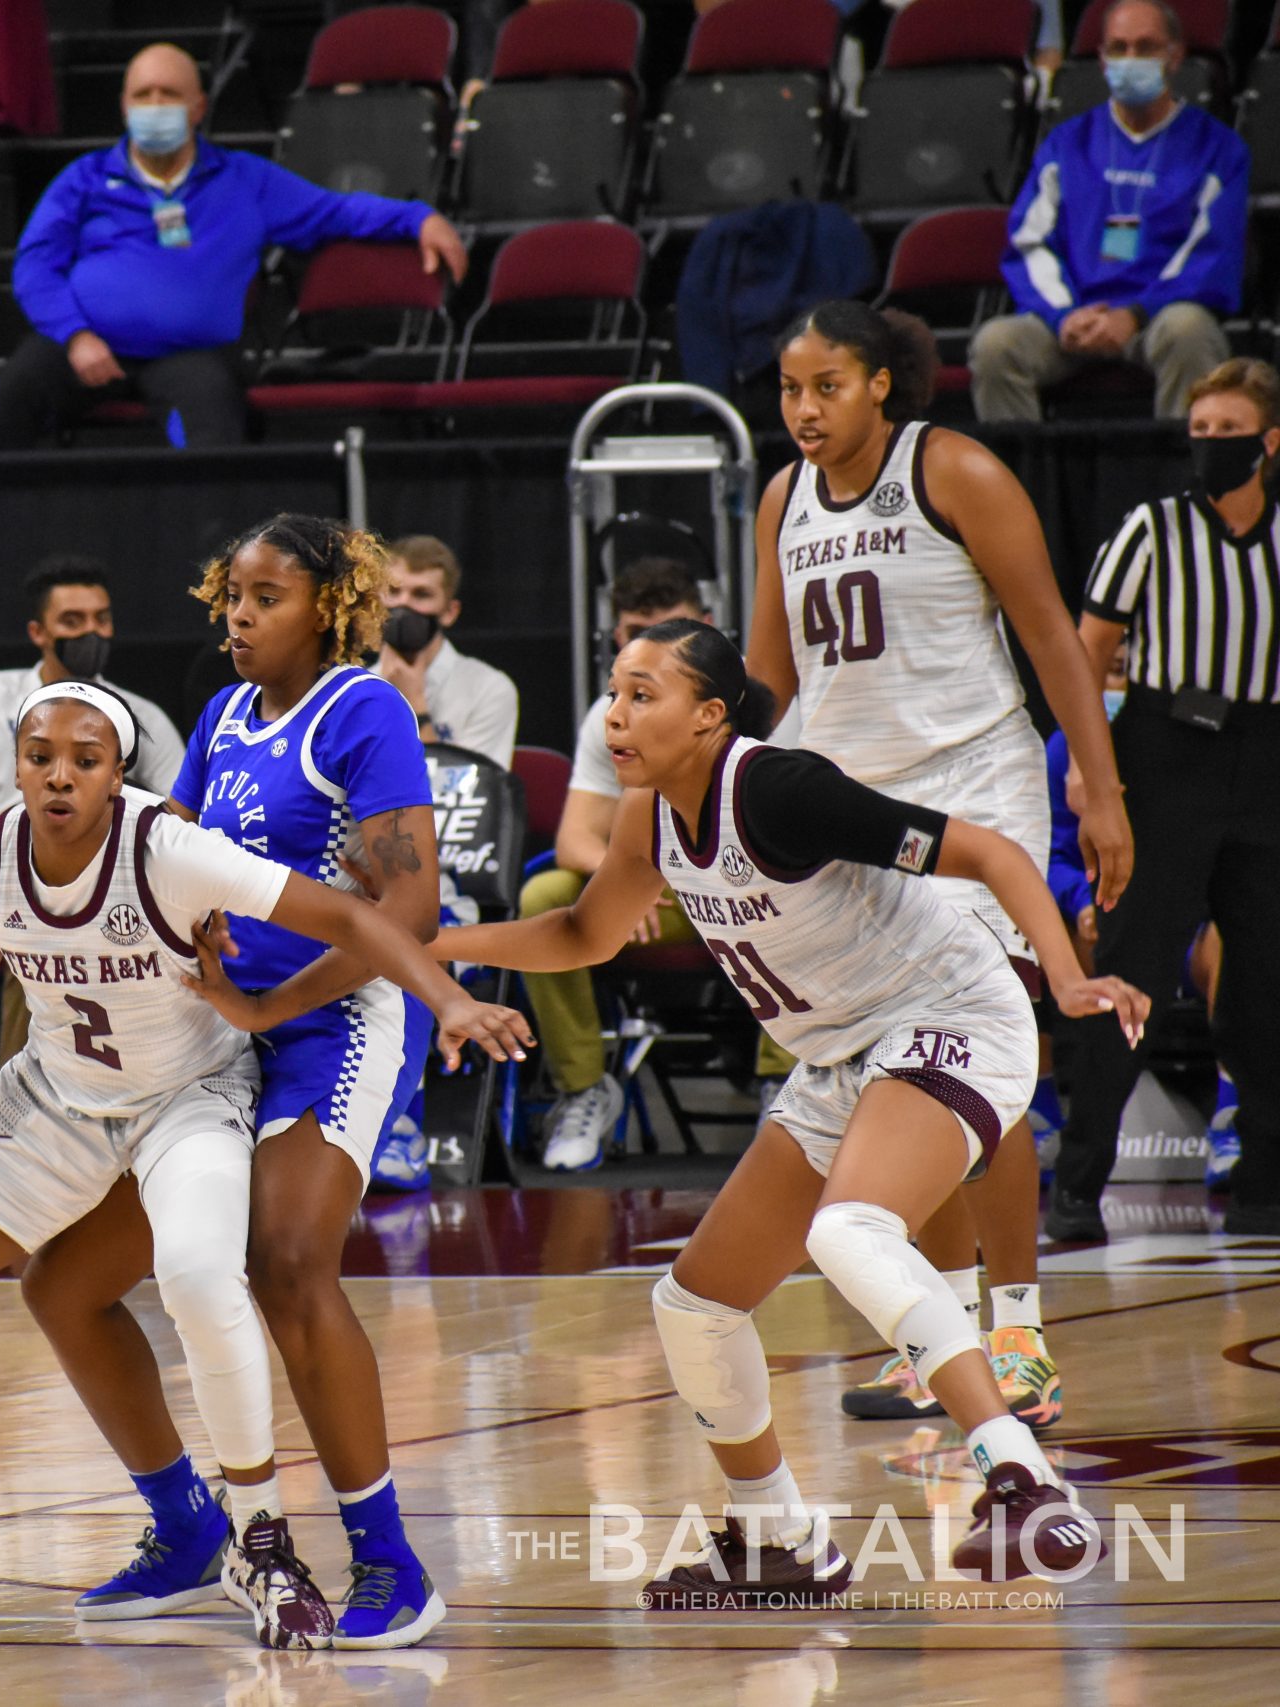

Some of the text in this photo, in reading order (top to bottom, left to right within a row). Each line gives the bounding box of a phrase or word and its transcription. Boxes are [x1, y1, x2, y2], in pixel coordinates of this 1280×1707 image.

[786, 526, 907, 576] TEXAS A&M
[802, 569, 886, 667] 40
[198, 770, 269, 854] NTUCKY
[3, 922, 27, 931] adidas
[108, 904, 141, 936] SEC
[725, 892, 782, 926] A&M
[0, 948, 163, 985] TEXAS A&M
[707, 938, 814, 1021] 31
[63, 993, 123, 1072] 2
